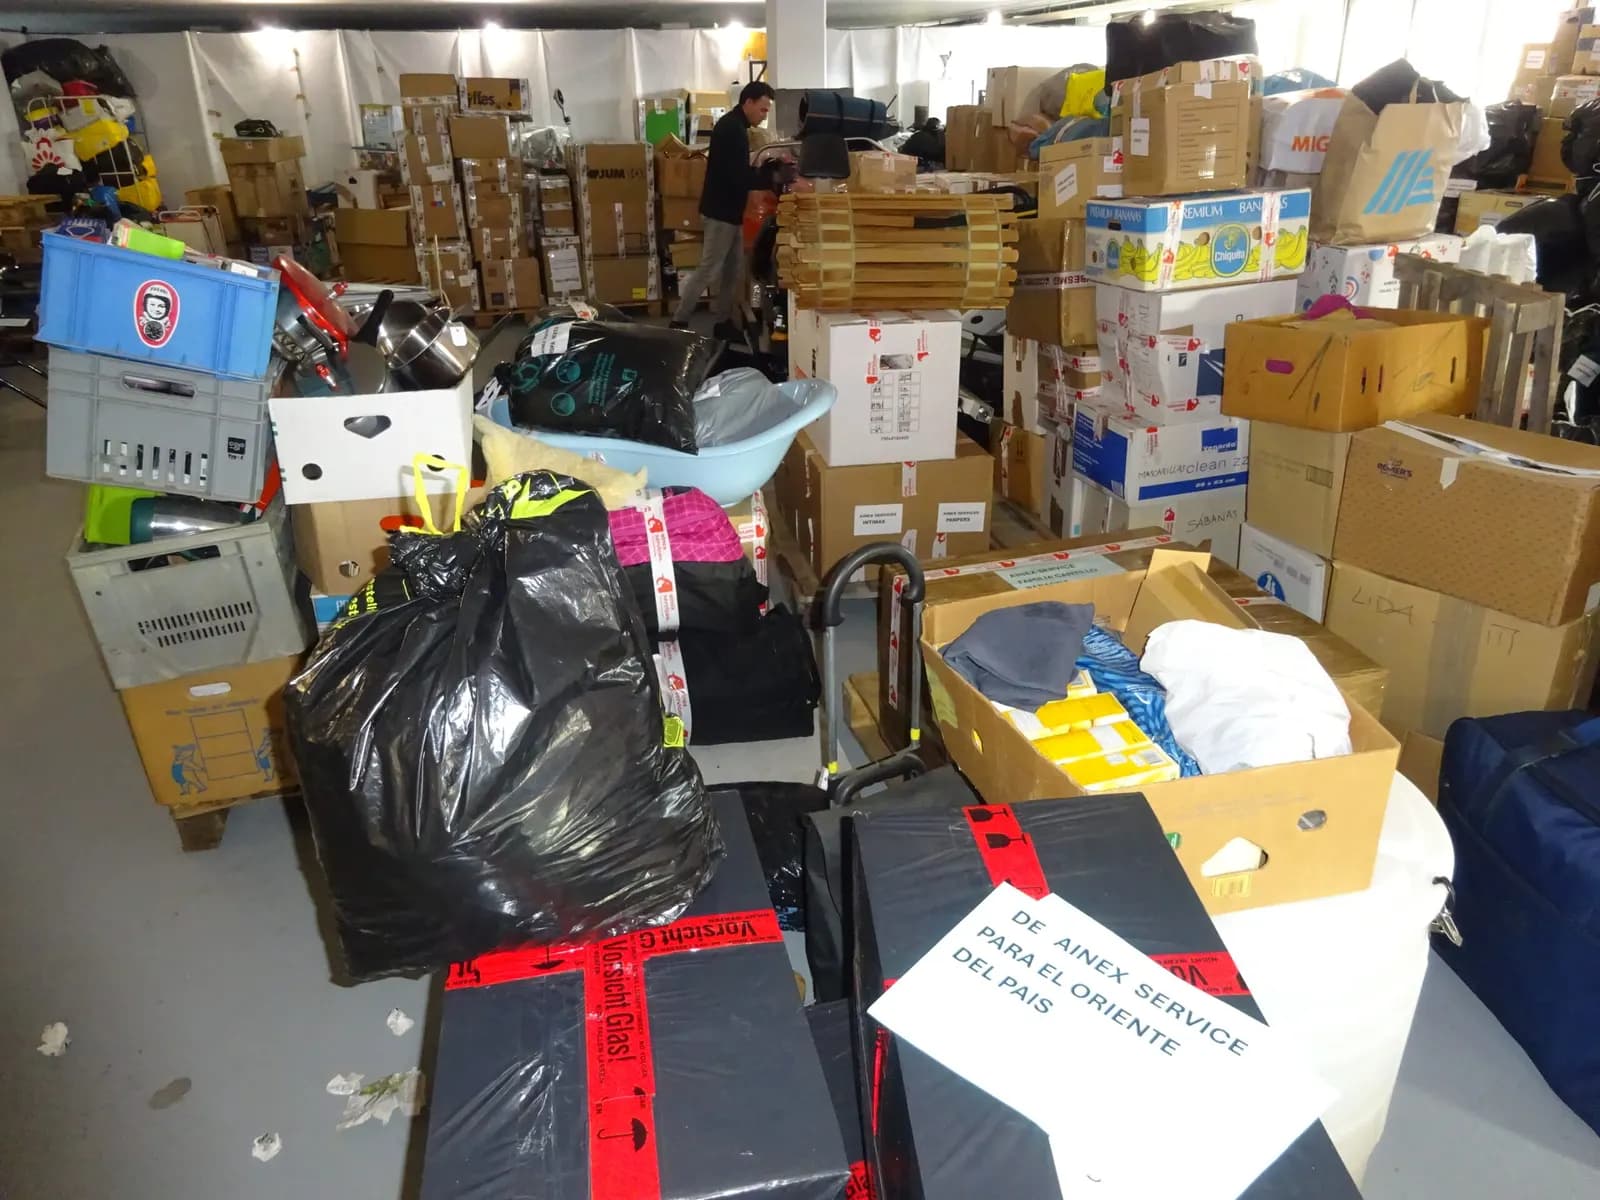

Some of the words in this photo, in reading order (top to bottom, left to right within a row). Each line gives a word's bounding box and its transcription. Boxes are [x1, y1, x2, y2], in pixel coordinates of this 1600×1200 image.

[1186, 459, 1226, 474] clean
[661, 920, 758, 943] Vorsicht
[602, 939, 632, 1010] Vorsicht
[952, 947, 993, 981] DEL
[998, 976, 1053, 1014] PAIS
[977, 926, 1034, 968] PARA
[1037, 963, 1062, 986] EL
[1070, 983, 1181, 1056] ORIENTE
[1011, 910, 1046, 934] DE
[1054, 937, 1129, 984] AINEX
[1134, 983, 1249, 1056] SERVICE
[606, 1012, 637, 1062] Glas!
